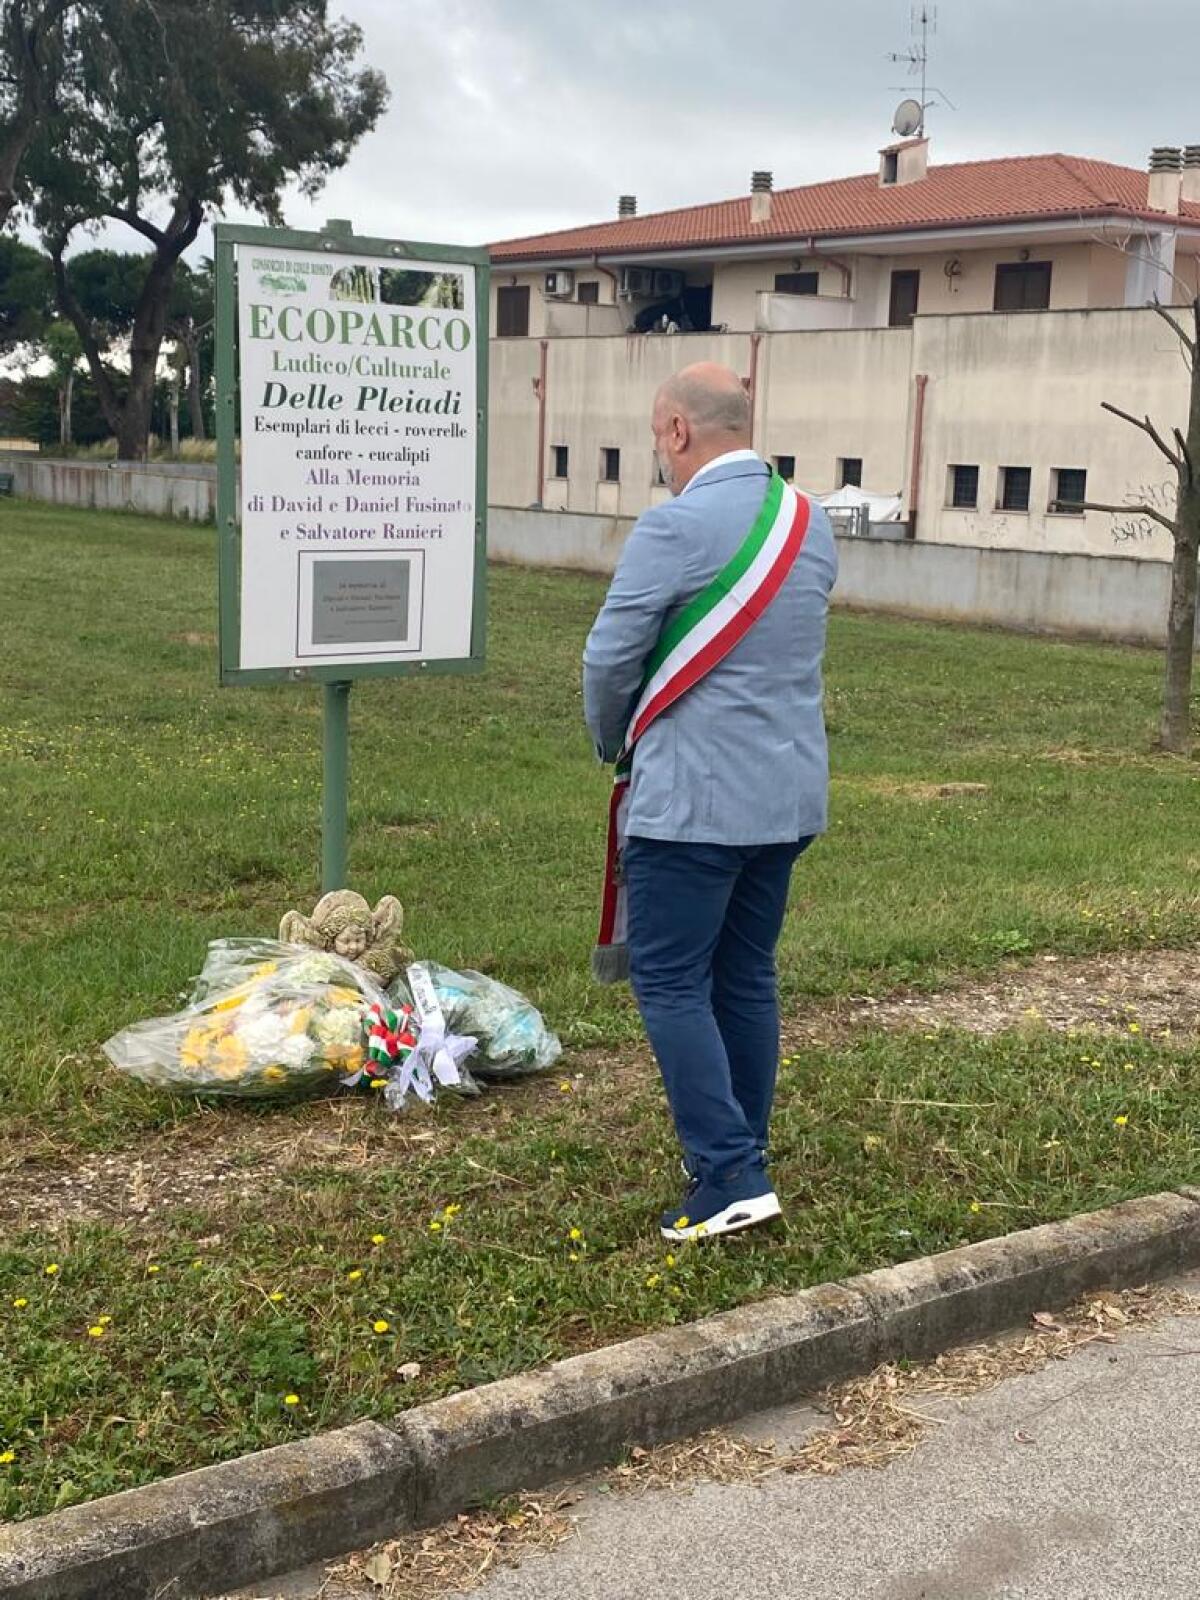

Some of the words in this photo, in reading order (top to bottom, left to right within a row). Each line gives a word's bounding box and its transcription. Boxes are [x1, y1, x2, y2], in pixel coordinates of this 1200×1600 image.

[248, 304, 471, 352] ECOPARCO
[272, 350, 451, 380] Ludico/Culturale
[260, 381, 343, 410] Delle
[355, 385, 462, 415] Pleiadi
[254, 416, 330, 437] Esemplari
[336, 419, 350, 434] di
[355, 420, 389, 435] lecci
[405, 422, 468, 438] roverelle
[296, 444, 352, 460] canfore
[369, 446, 431, 466] eucalipti
[305, 468, 340, 485] Alla
[346, 469, 421, 486] Memoria
[247, 496, 264, 512] di
[271, 495, 322, 512] David
[329, 502, 338, 512] e
[345, 496, 399, 512] Daniel
[280, 529, 290, 539] e
[296, 523, 376, 540] Salvatore
[382, 523, 443, 539] Ranieri
